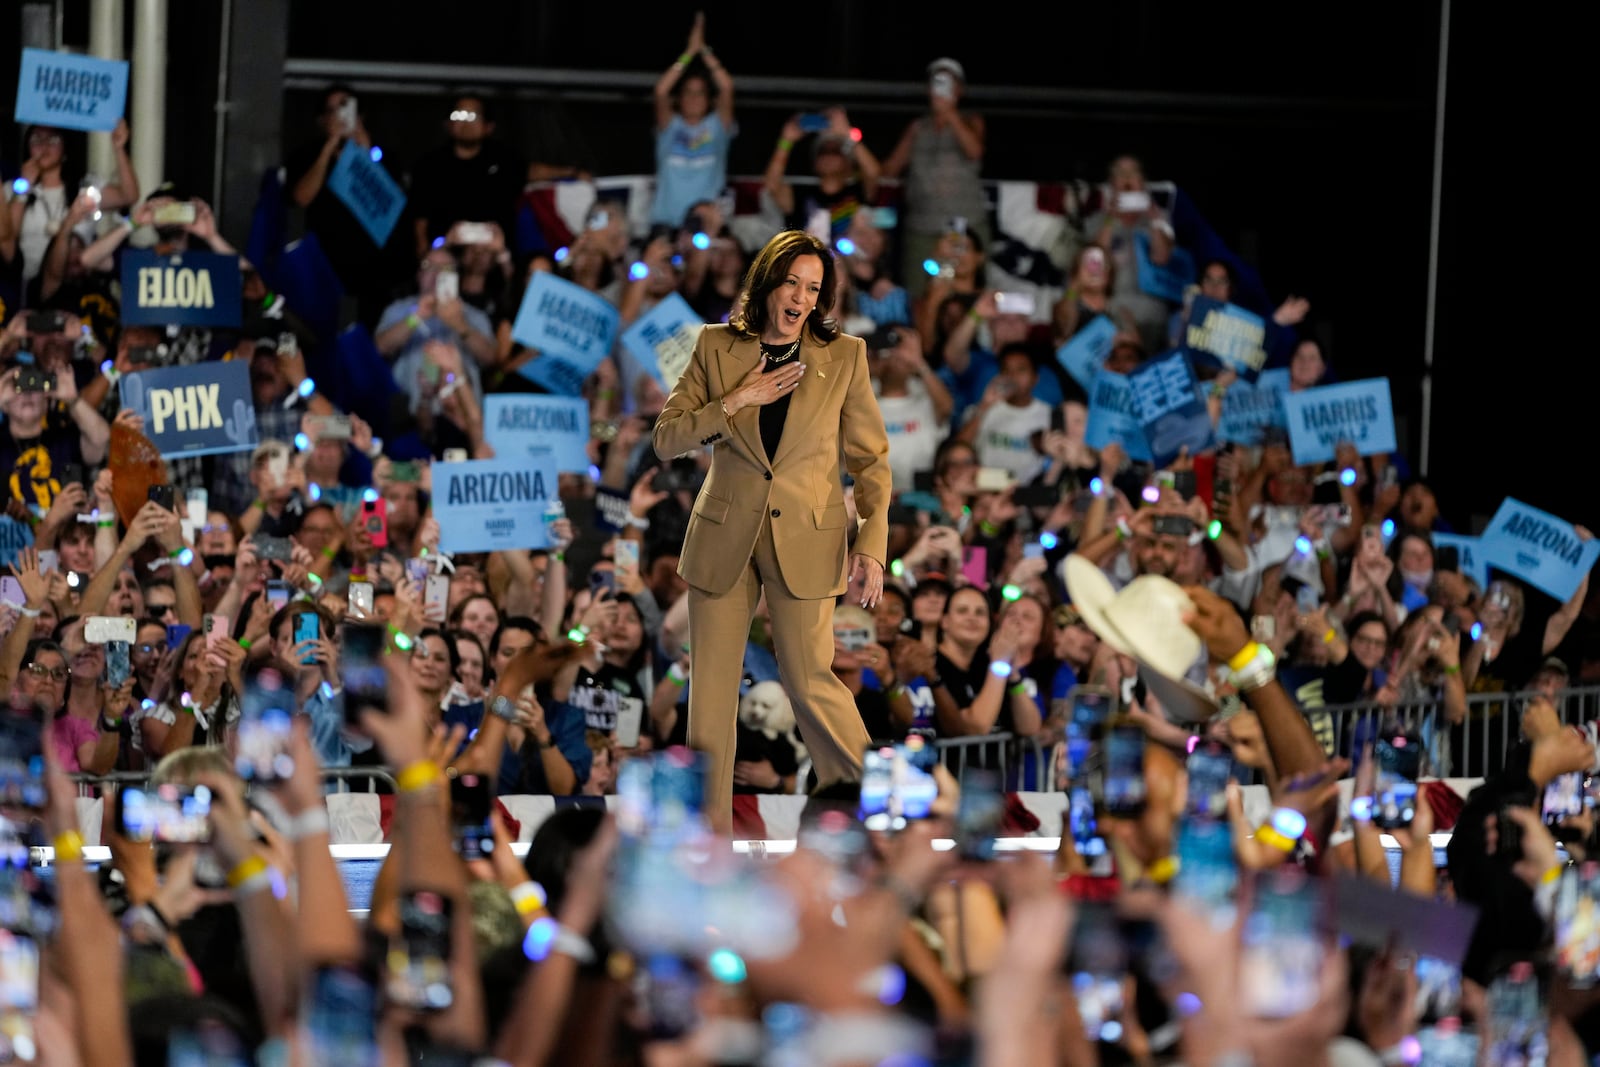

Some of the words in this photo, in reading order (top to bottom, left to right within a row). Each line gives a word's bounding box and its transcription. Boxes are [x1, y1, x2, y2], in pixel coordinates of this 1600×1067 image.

[35, 64, 113, 100] HARRIS
[44, 94, 98, 116] WALZ
[138, 267, 215, 308] VOTE!
[537, 289, 609, 341] HARRIS
[545, 322, 593, 353] WALZ
[150, 383, 223, 434] PHX
[497, 404, 580, 434] ARIZONA
[1301, 395, 1378, 431] HARRIS
[447, 470, 547, 505] ARIZONA
[1502, 511, 1585, 566] ARIZONA
